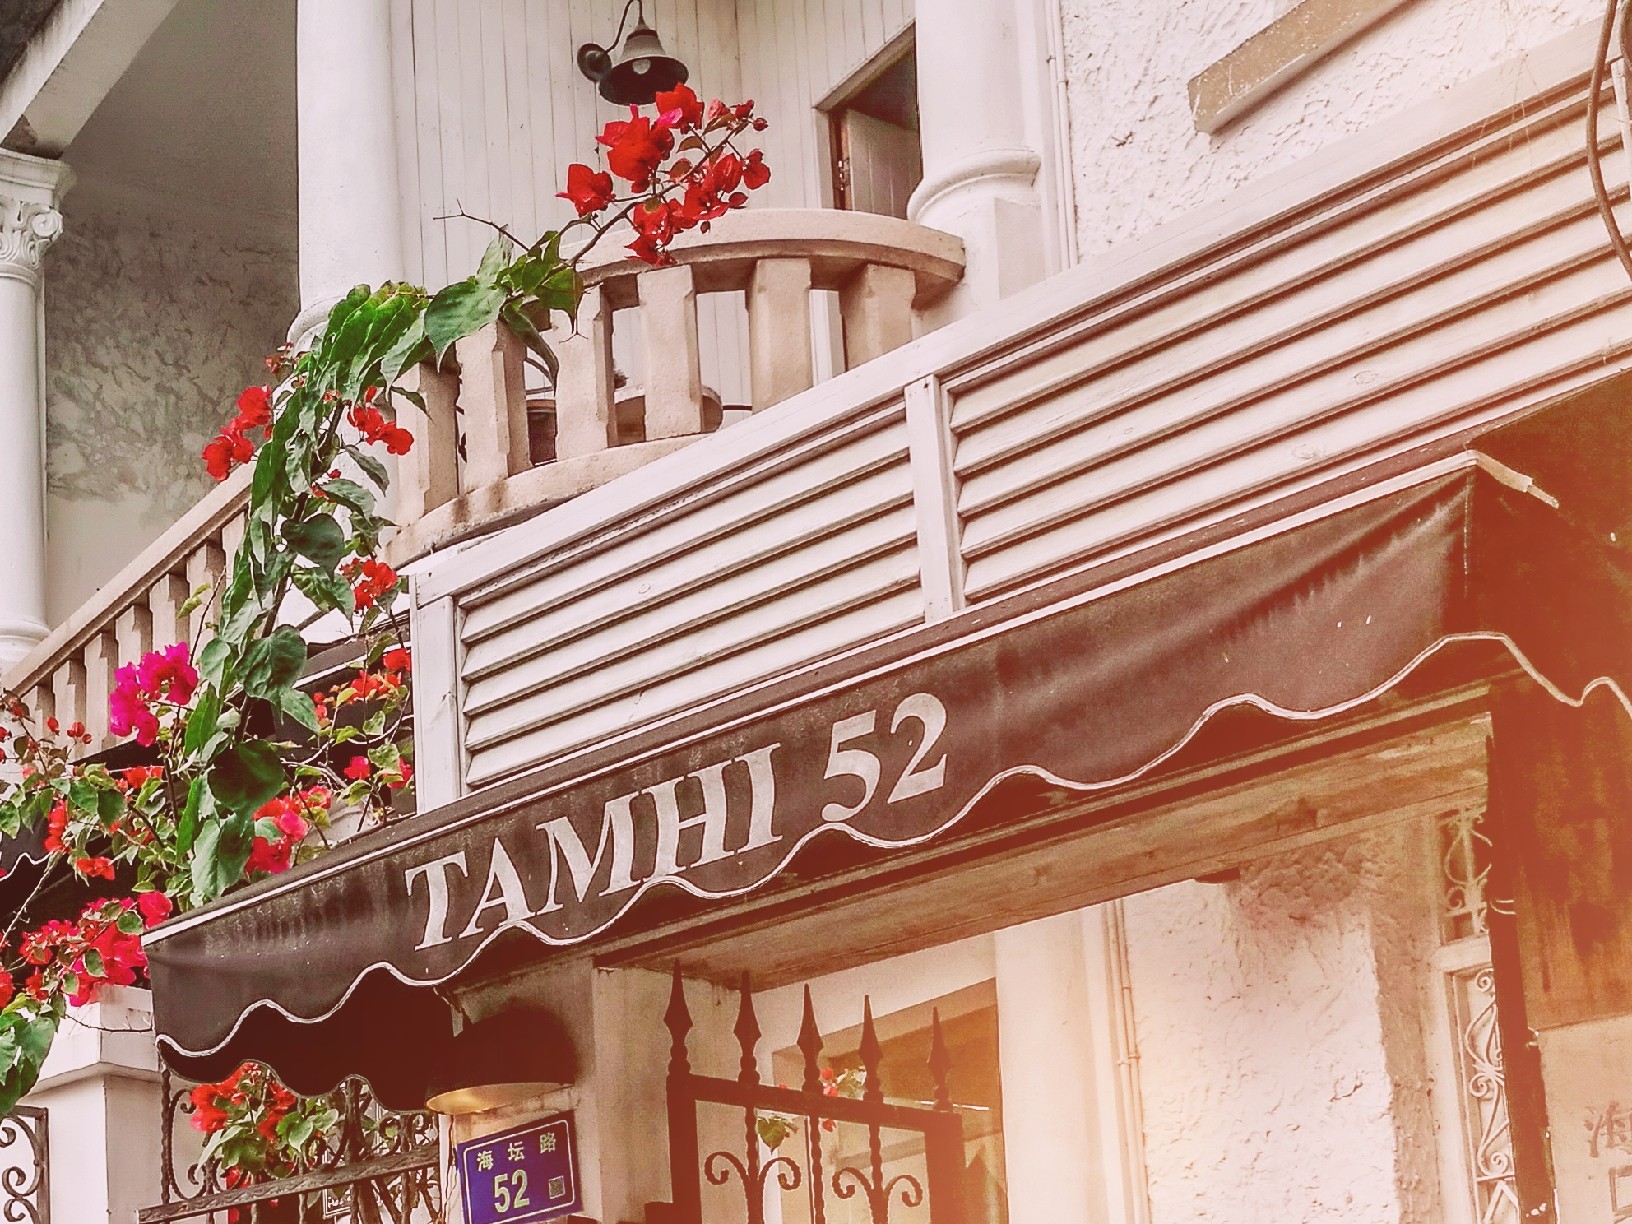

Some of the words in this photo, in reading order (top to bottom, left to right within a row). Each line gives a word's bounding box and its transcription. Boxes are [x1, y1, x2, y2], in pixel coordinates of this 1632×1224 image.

[405, 743, 783, 951] TAMHI
[821, 692, 948, 821] 52
[476, 1132, 556, 1172] 海坛路
[493, 1169, 530, 1213] 52
